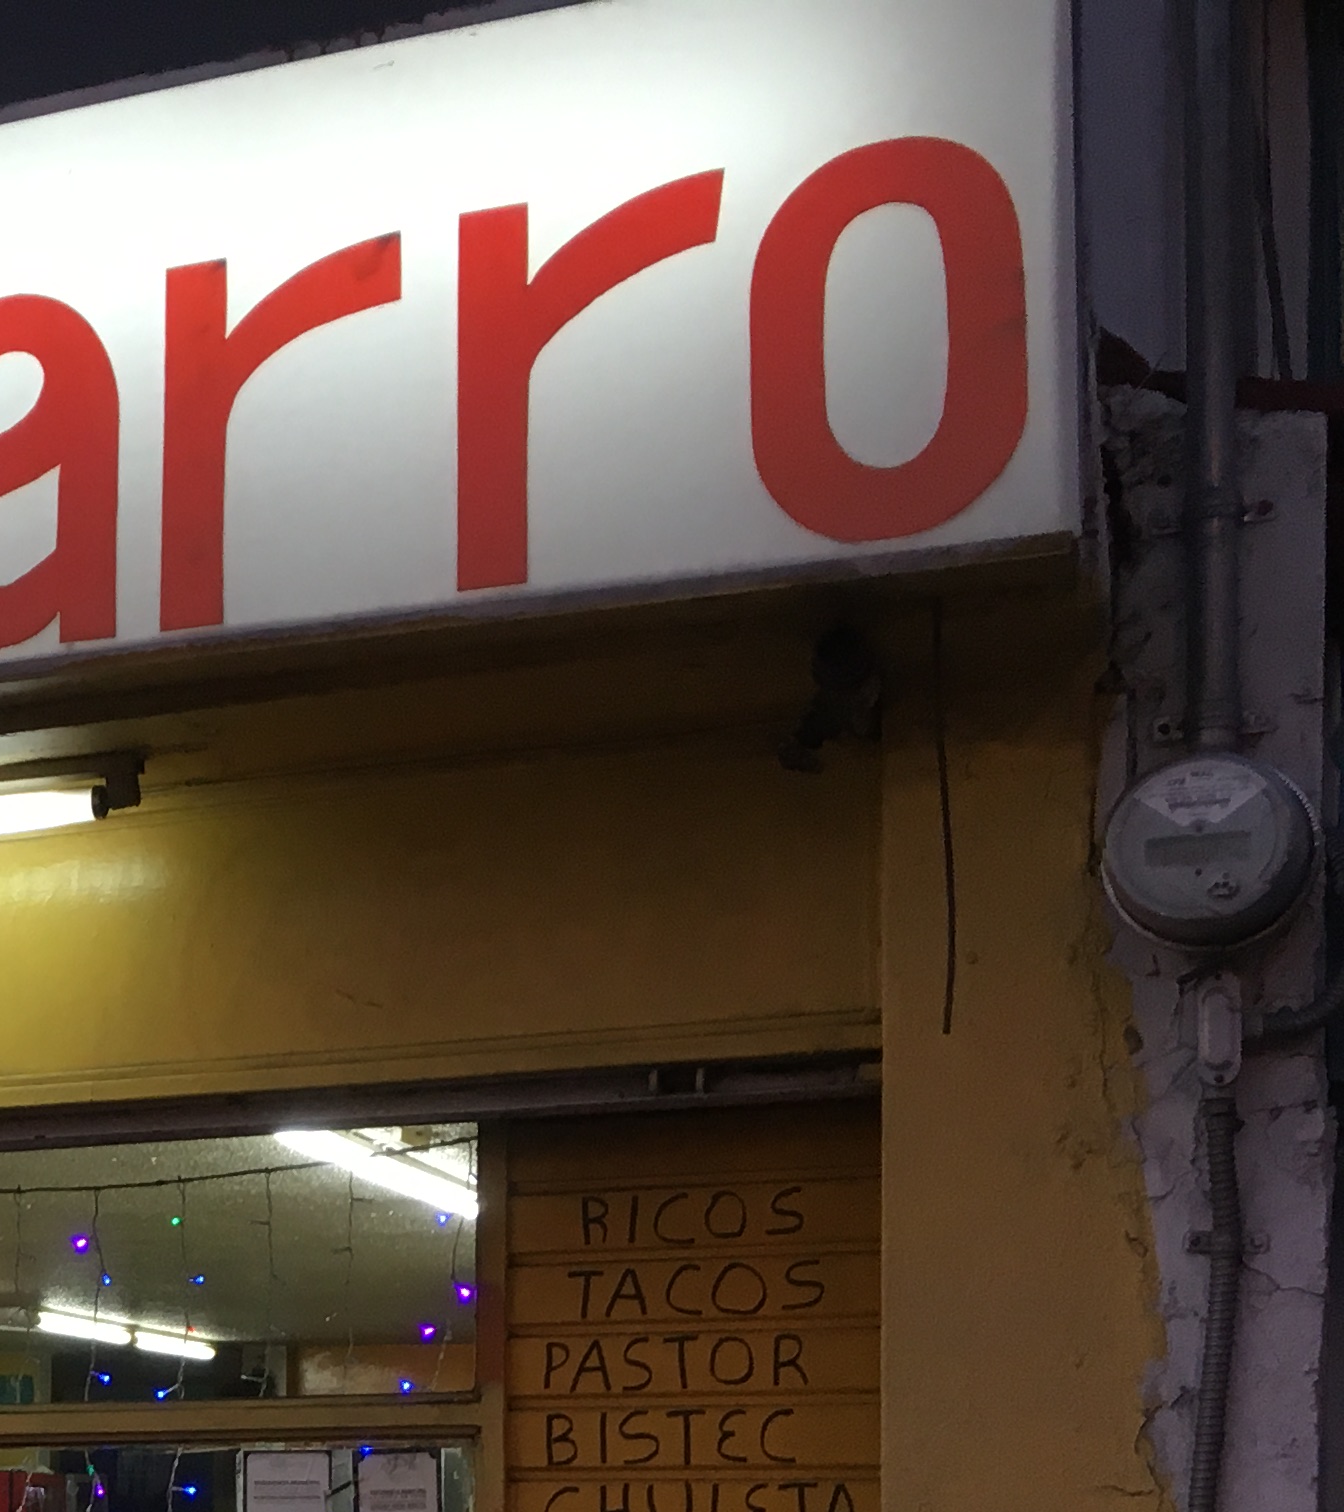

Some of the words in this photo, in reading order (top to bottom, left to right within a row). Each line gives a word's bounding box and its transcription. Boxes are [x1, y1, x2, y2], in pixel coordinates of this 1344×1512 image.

[580, 1186, 805, 1245] RICOS
[567, 1259, 825, 1318] TACOS
[543, 1334, 808, 1393] PASTOR
[545, 1408, 797, 1466] BISTEC
